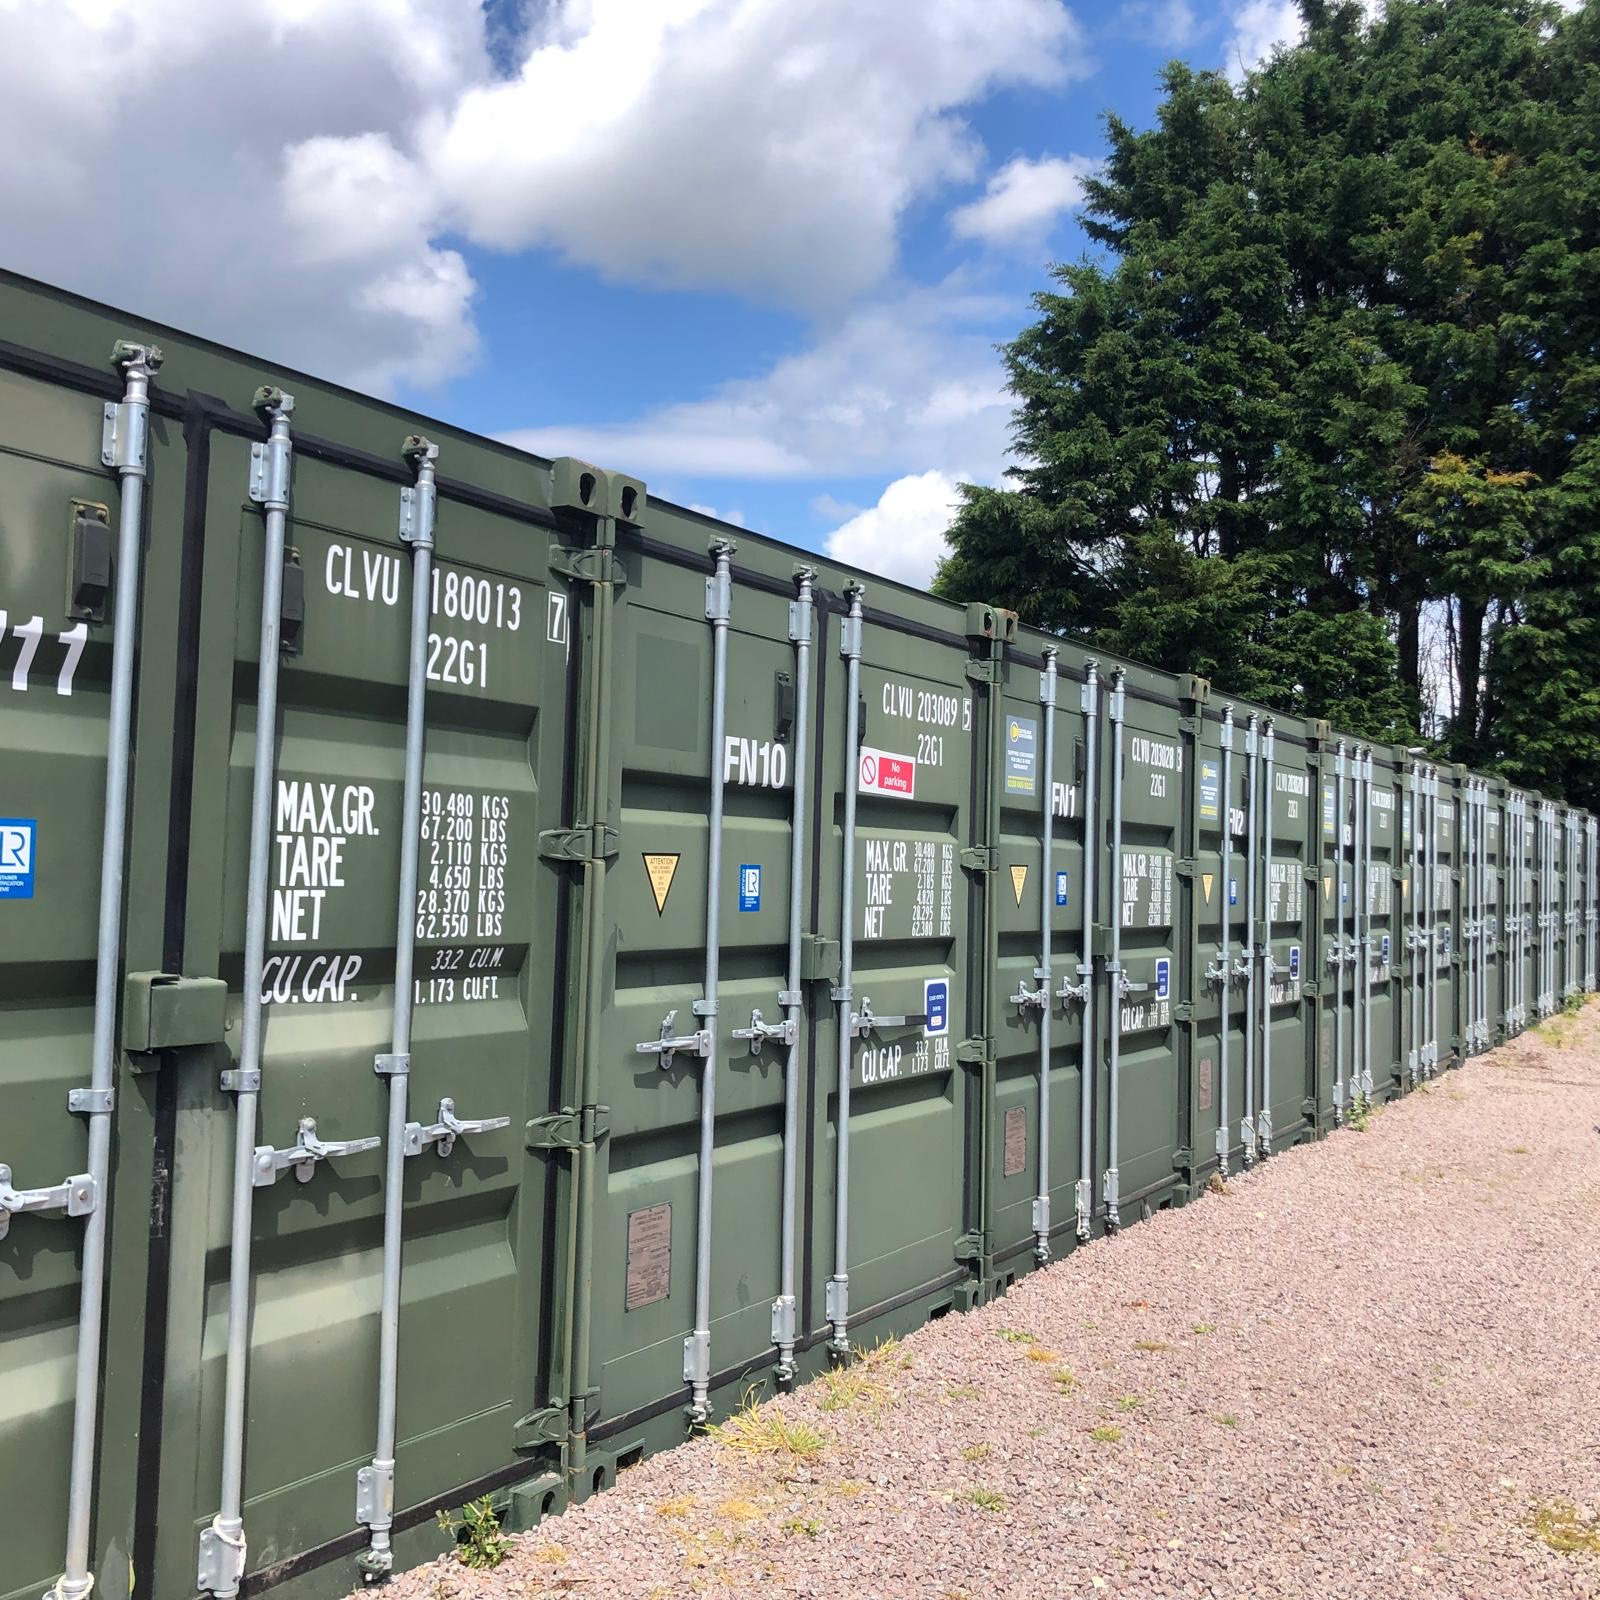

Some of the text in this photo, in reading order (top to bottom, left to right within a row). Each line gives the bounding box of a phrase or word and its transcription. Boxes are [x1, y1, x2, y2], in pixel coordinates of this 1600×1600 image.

[325, 544, 565, 641] CLVU 180013 7
[426, 633, 487, 688] 22G1
[883, 682, 971, 730] CLVU 203089 5
[722, 735, 786, 789] FN10
[917, 733, 943, 767] 22G1
[884, 776, 906, 791] parking
[891, 761, 900, 773] No
[276, 780, 379, 835] MAX.GR.
[482, 795, 509, 819] KGS
[1052, 782, 1076, 818] FN1
[481, 819, 506, 843] LBS
[276, 835, 346, 887] TARE
[480, 842, 507, 866] KGS
[479, 866, 504, 889] LBS
[866, 873, 892, 905] TARE
[271, 889, 326, 941] NET
[478, 890, 505, 913] KGS
[476, 913, 502, 937] LBS
[864, 906, 885, 938] NET
[430, 949, 464, 970] 33.2
